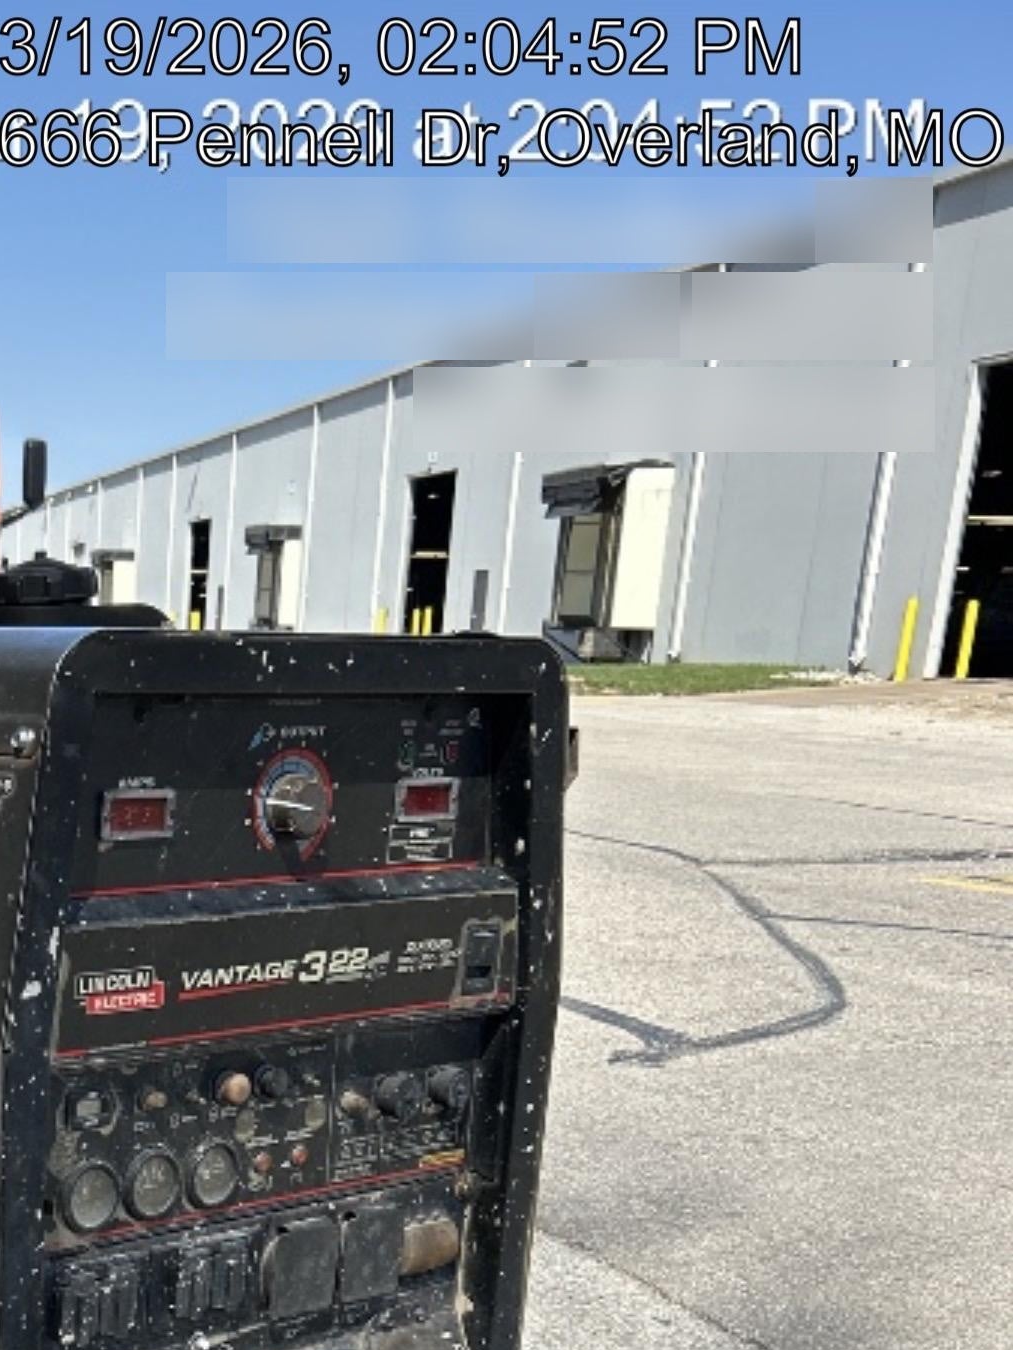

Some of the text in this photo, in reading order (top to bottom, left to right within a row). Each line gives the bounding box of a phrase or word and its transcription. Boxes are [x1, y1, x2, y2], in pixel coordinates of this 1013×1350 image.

[79, 970, 151, 994] LINCOLN
[180, 959, 298, 991] VANTAGE
[298, 947, 370, 983] 322
